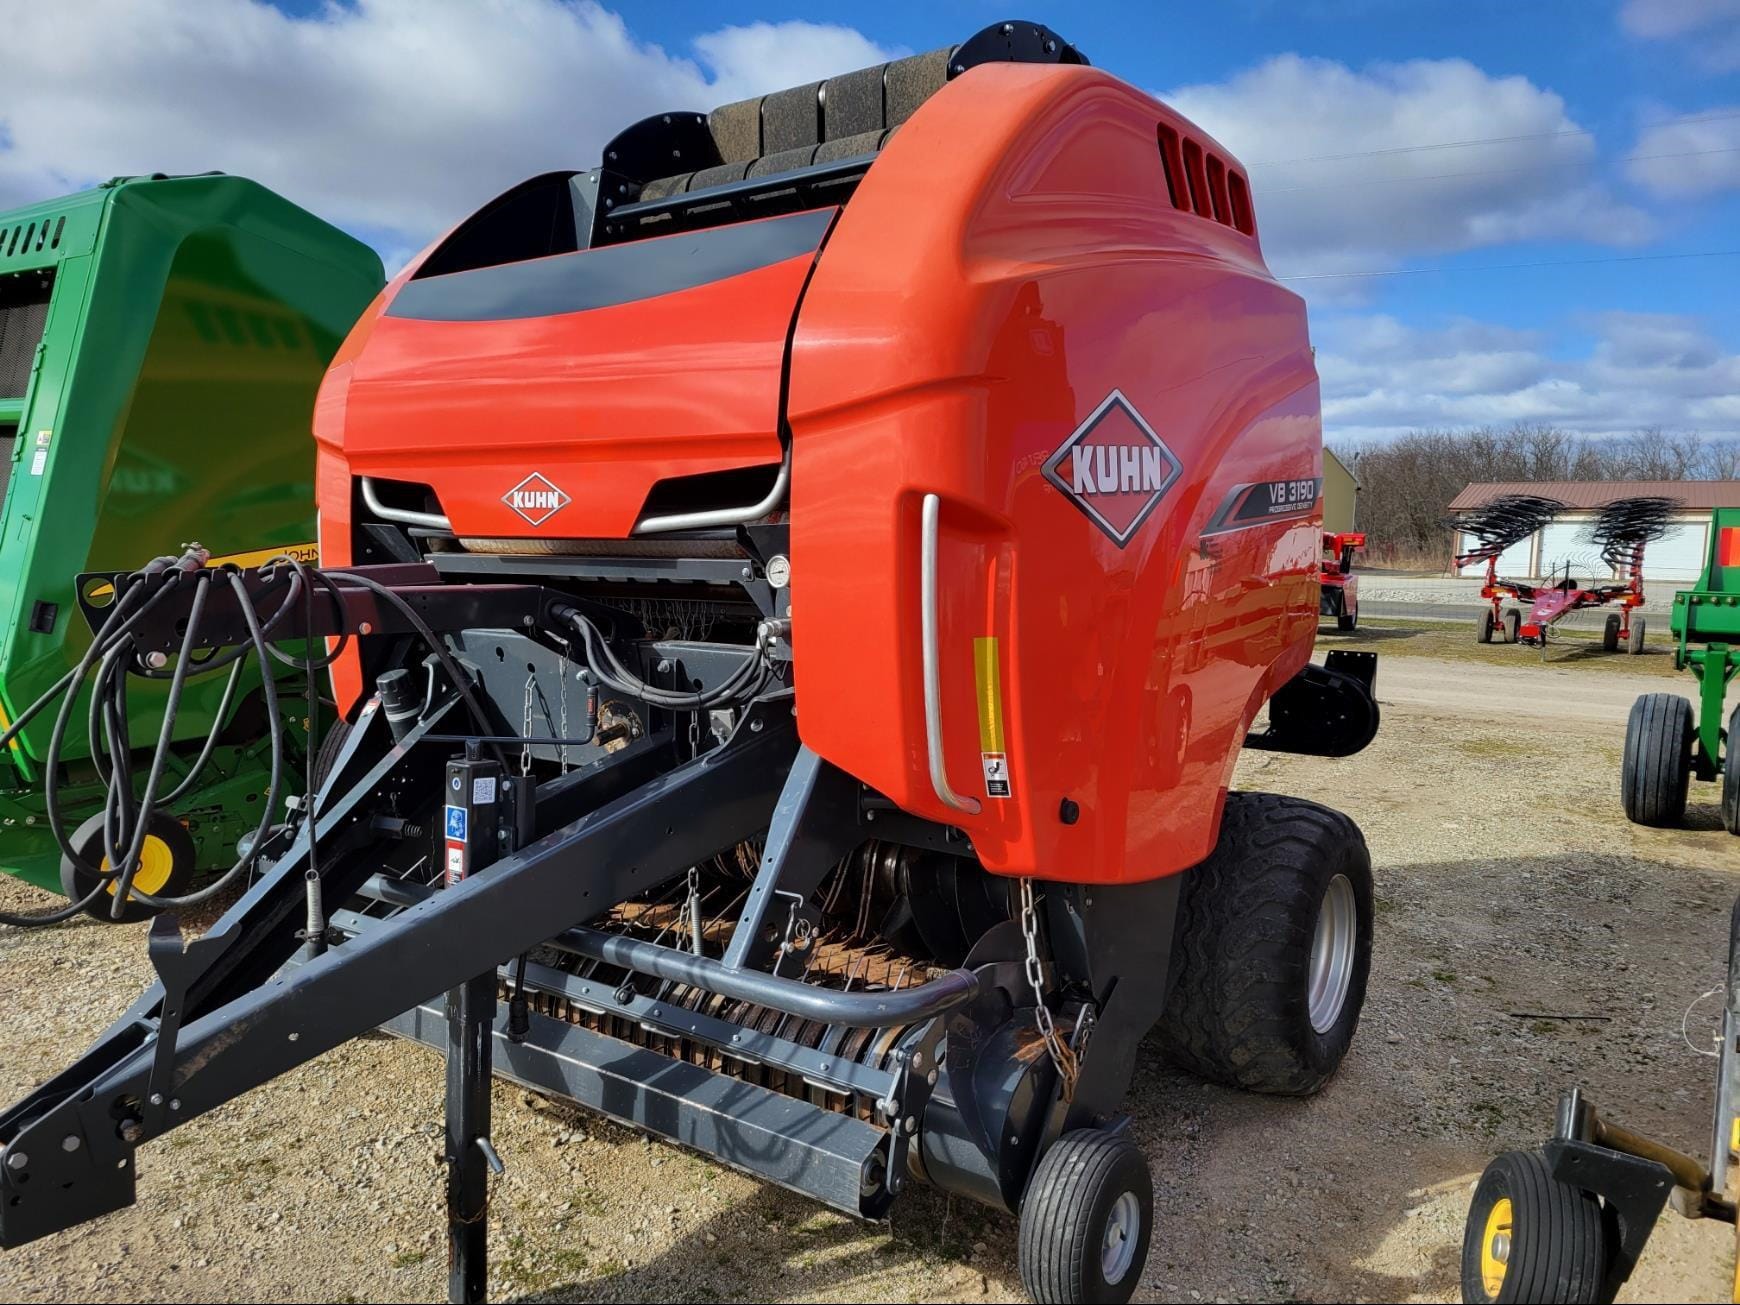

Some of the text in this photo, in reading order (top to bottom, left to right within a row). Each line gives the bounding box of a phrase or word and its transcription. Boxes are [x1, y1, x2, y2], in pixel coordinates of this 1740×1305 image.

[1072, 445, 1162, 494] KUHN
[513, 491, 559, 509] KUHN
[1269, 480, 1314, 504] VB 3190
